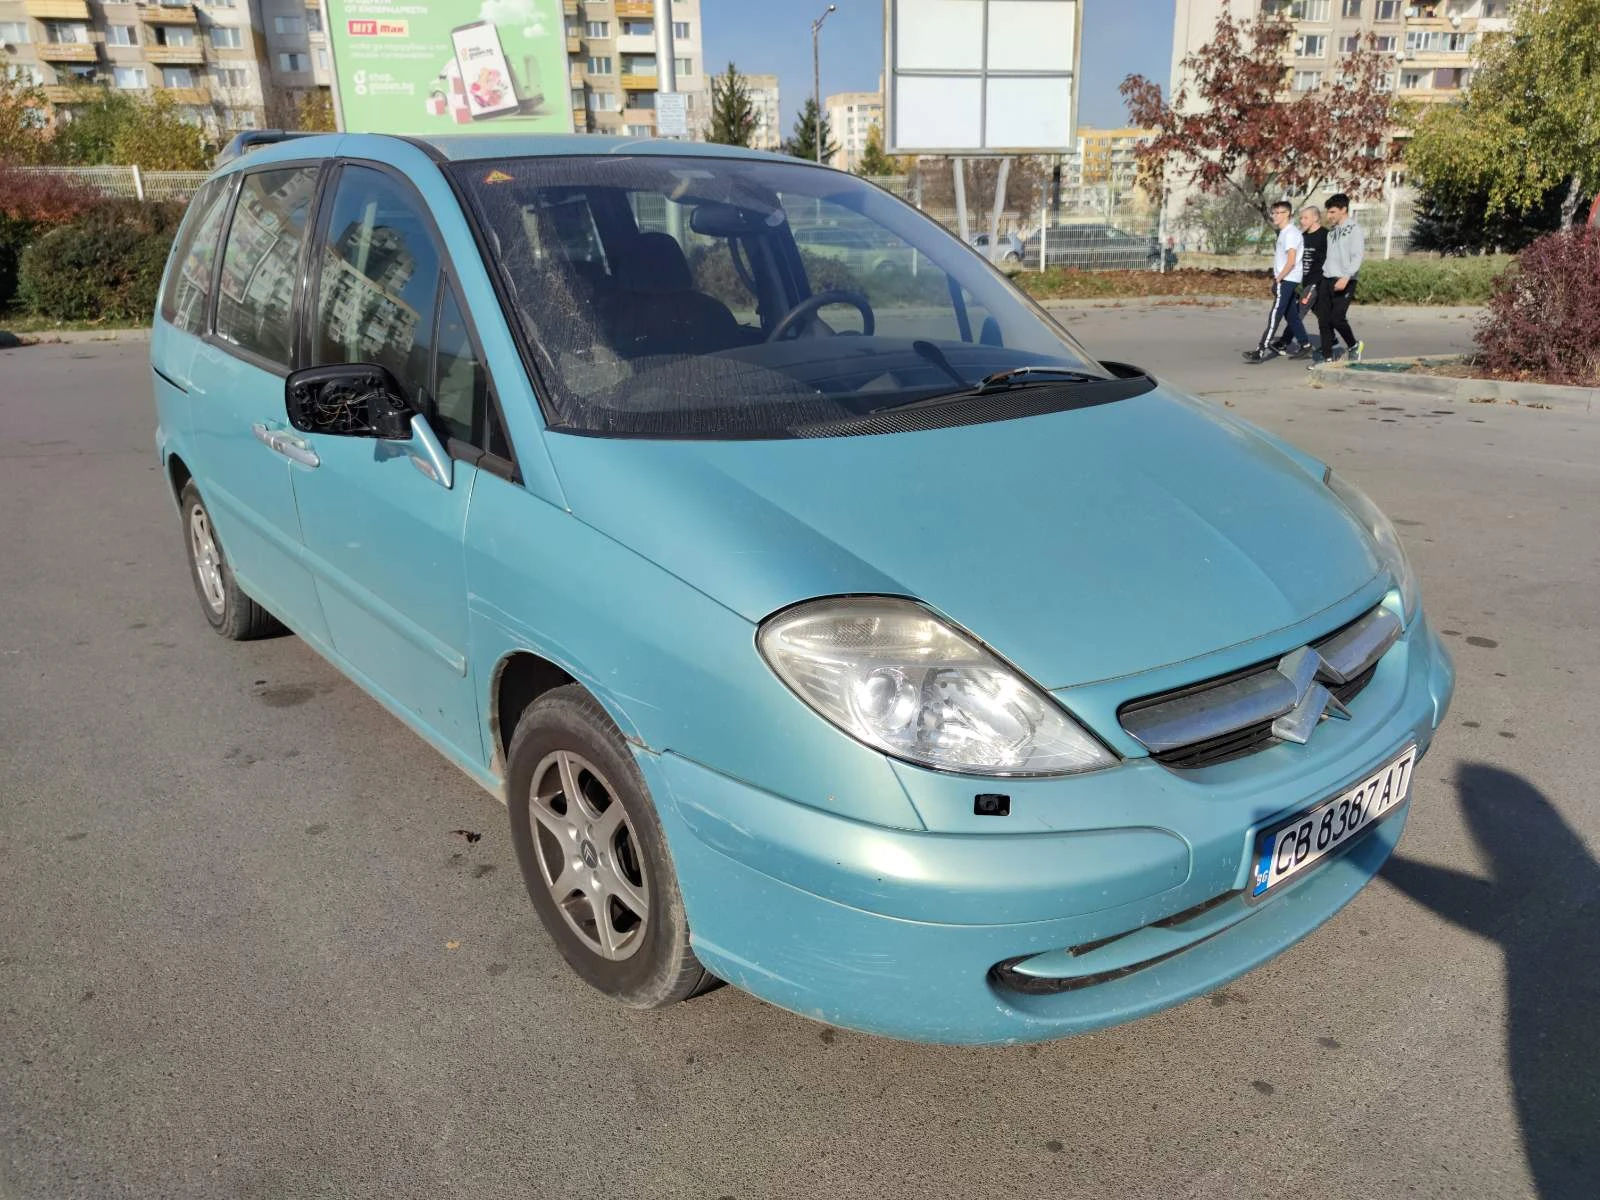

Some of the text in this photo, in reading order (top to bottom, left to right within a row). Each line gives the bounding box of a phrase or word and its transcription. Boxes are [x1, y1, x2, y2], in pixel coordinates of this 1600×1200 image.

[352, 22, 374, 33] HIT
[1276, 757, 1411, 875] CB 8387 AT
